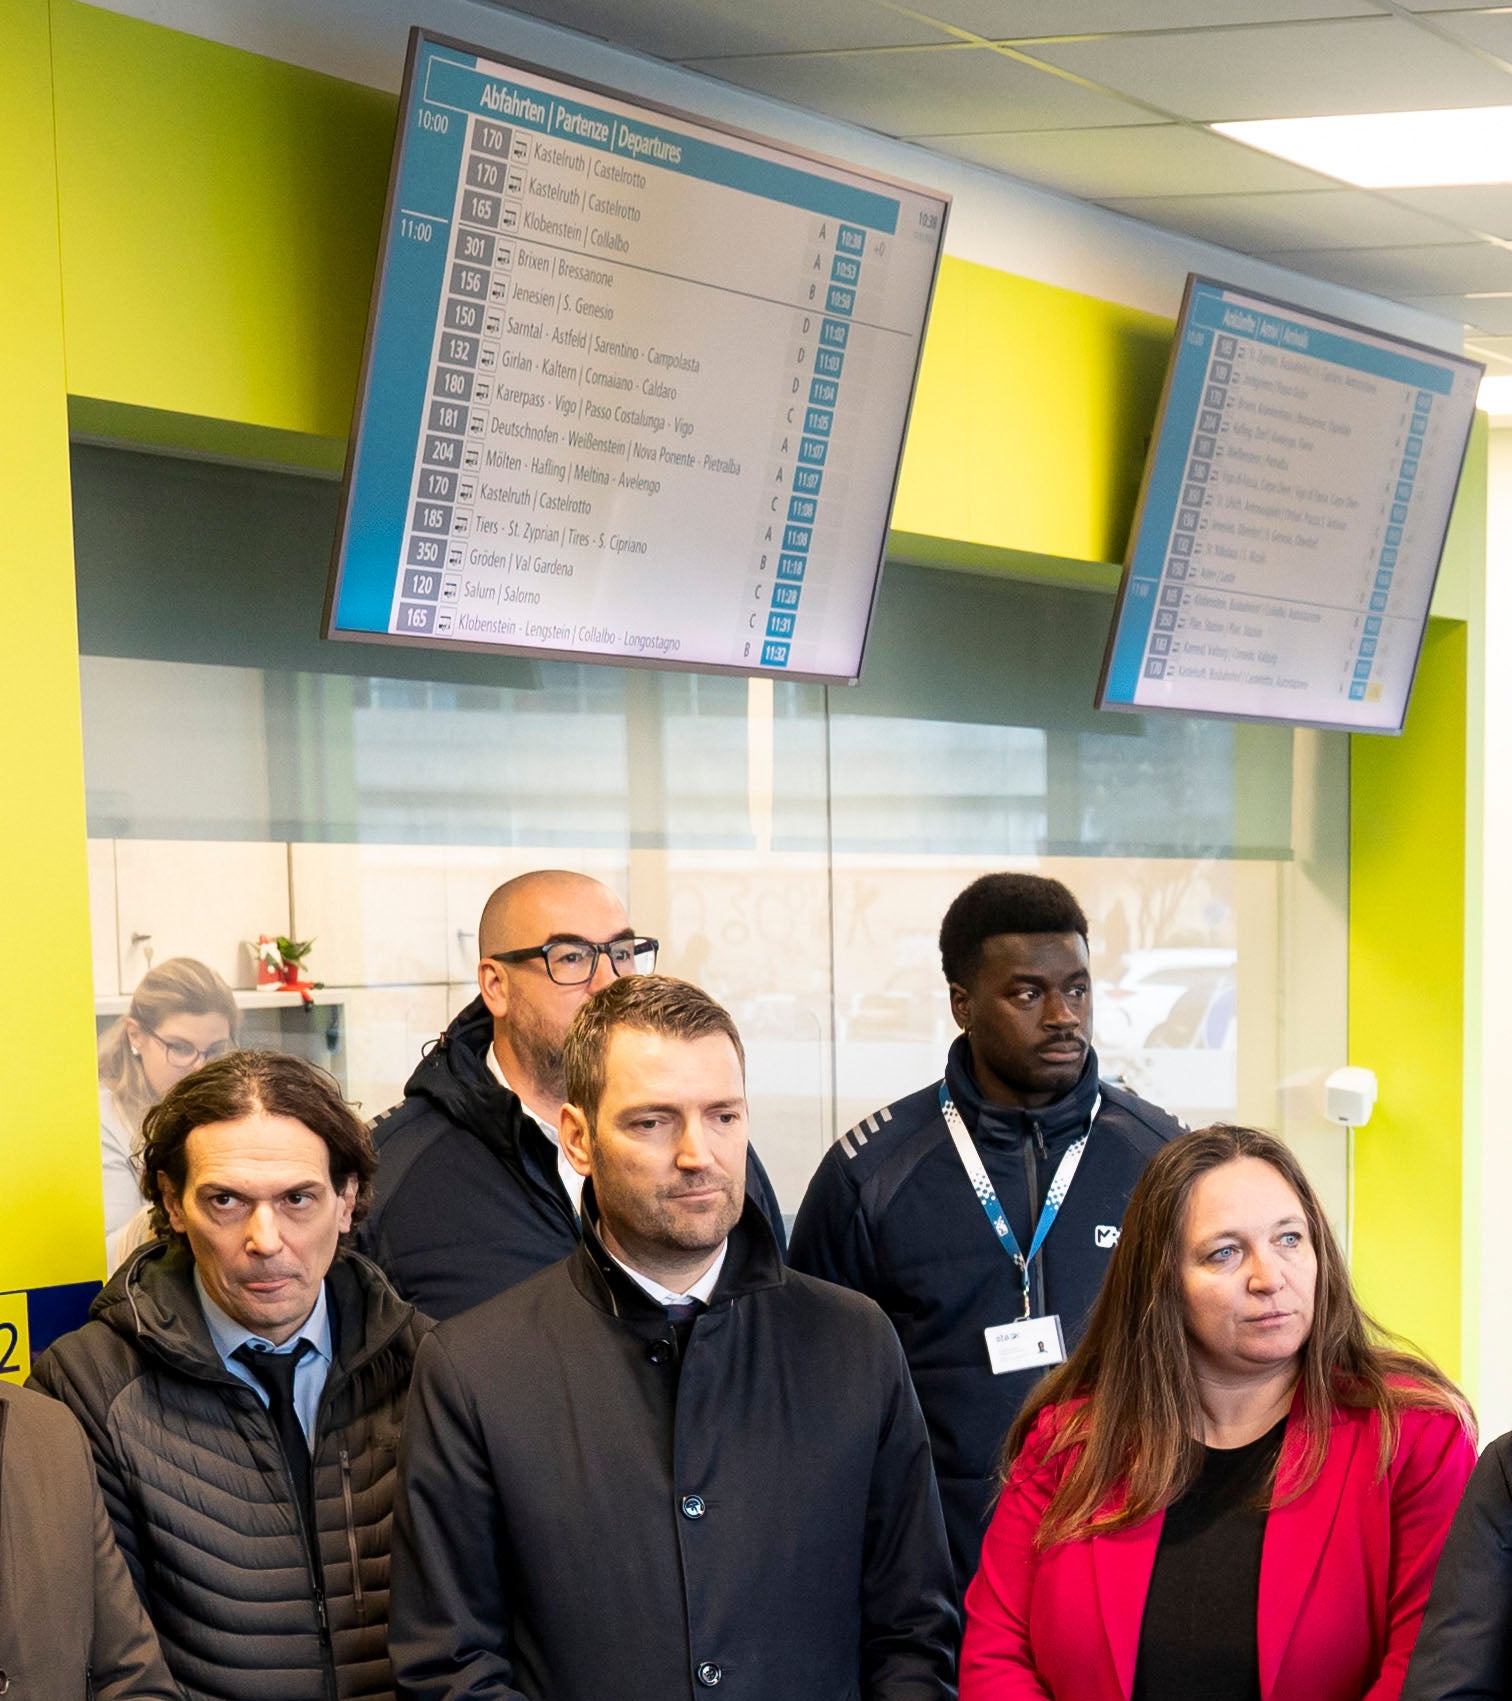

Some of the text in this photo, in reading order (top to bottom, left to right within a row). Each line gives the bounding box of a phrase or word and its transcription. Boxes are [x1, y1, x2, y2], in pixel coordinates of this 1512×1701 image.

[417, 108, 449, 135] 10:00
[479, 84, 682, 164] Abfahrten Partenze Departures
[477, 162, 498, 186] 170
[528, 177, 580, 206] Kastelruth
[588, 193, 641, 223] Castelrotto
[813, 253, 821, 271] A
[482, 127, 503, 150] 170
[533, 142, 586, 172] Kastelruth
[593, 159, 647, 190] Castelrotto
[818, 223, 826, 240] A
[401, 218, 433, 243] 11:00
[472, 197, 493, 220] 165
[523, 211, 582, 241] Klobenstein
[590, 228, 630, 254] Collalbo
[808, 283, 816, 301] B
[460, 270, 482, 293] 156
[511, 282, 556, 308] Jenesien
[575, 296, 614, 321] Genesio
[797, 347, 806, 364] D
[464, 235, 486, 258] 301
[517, 248, 550, 272] Brixen
[558, 258, 614, 288] Bressanone
[802, 317, 811, 334] D
[450, 339, 470, 361] 132
[501, 349, 533, 372] Girlan
[541, 358, 577, 380] Kaltern
[585, 367, 634, 392] Cornaiano
[641, 378, 677, 401] Caldaro
[786, 406, 795, 424] C
[455, 304, 476, 327] 150
[506, 316, 544, 339] Sarntal
[551, 326, 588, 349] Astfeld
[593, 335, 639, 361] Sarentino
[791, 376, 800, 394] D
[439, 407, 459, 428] 181
[490, 416, 559, 444] Deutschnofen
[568, 430, 626, 456] Weißenstein
[633, 441, 657, 461] Nova
[659, 446, 696, 468] Ponente
[703, 454, 741, 476] Pietralba
[775, 466, 783, 483] A
[444, 373, 465, 394] 180
[496, 383, 545, 409] Karerpass
[555, 394, 577, 418] Vigo
[584, 399, 612, 421] Passo
[614, 405, 666, 434] Costalunga
[674, 416, 695, 439] Vigo
[780, 437, 789, 453] A
[428, 474, 450, 496] 170
[480, 483, 531, 506] Kastelruth
[539, 492, 592, 515] Castelrotto
[764, 526, 772, 542] A
[432, 440, 455, 462] 204
[485, 449, 522, 471] Mölten
[530, 456, 567, 483] Hafling
[573, 464, 610, 485] Meltina
[617, 471, 661, 497] Avelengo
[770, 495, 779, 512] C
[416, 541, 439, 562] 350
[469, 548, 507, 568] Gröden
[515, 554, 532, 571] Val
[533, 556, 574, 577] Gardena
[754, 583, 762, 600] C
[423, 508, 444, 528] 185
[475, 515, 499, 535] Tiers
[522, 521, 560, 544] Zyprian
[568, 527, 590, 547] Tires
[609, 534, 648, 555] Cipriano
[759, 554, 767, 571] B
[407, 607, 787, 662] 165 Klobenstein Lengstein Collalbo Longostagno B 11:32
[412, 574, 792, 633] 120 Salurn Salorno C 11:31
